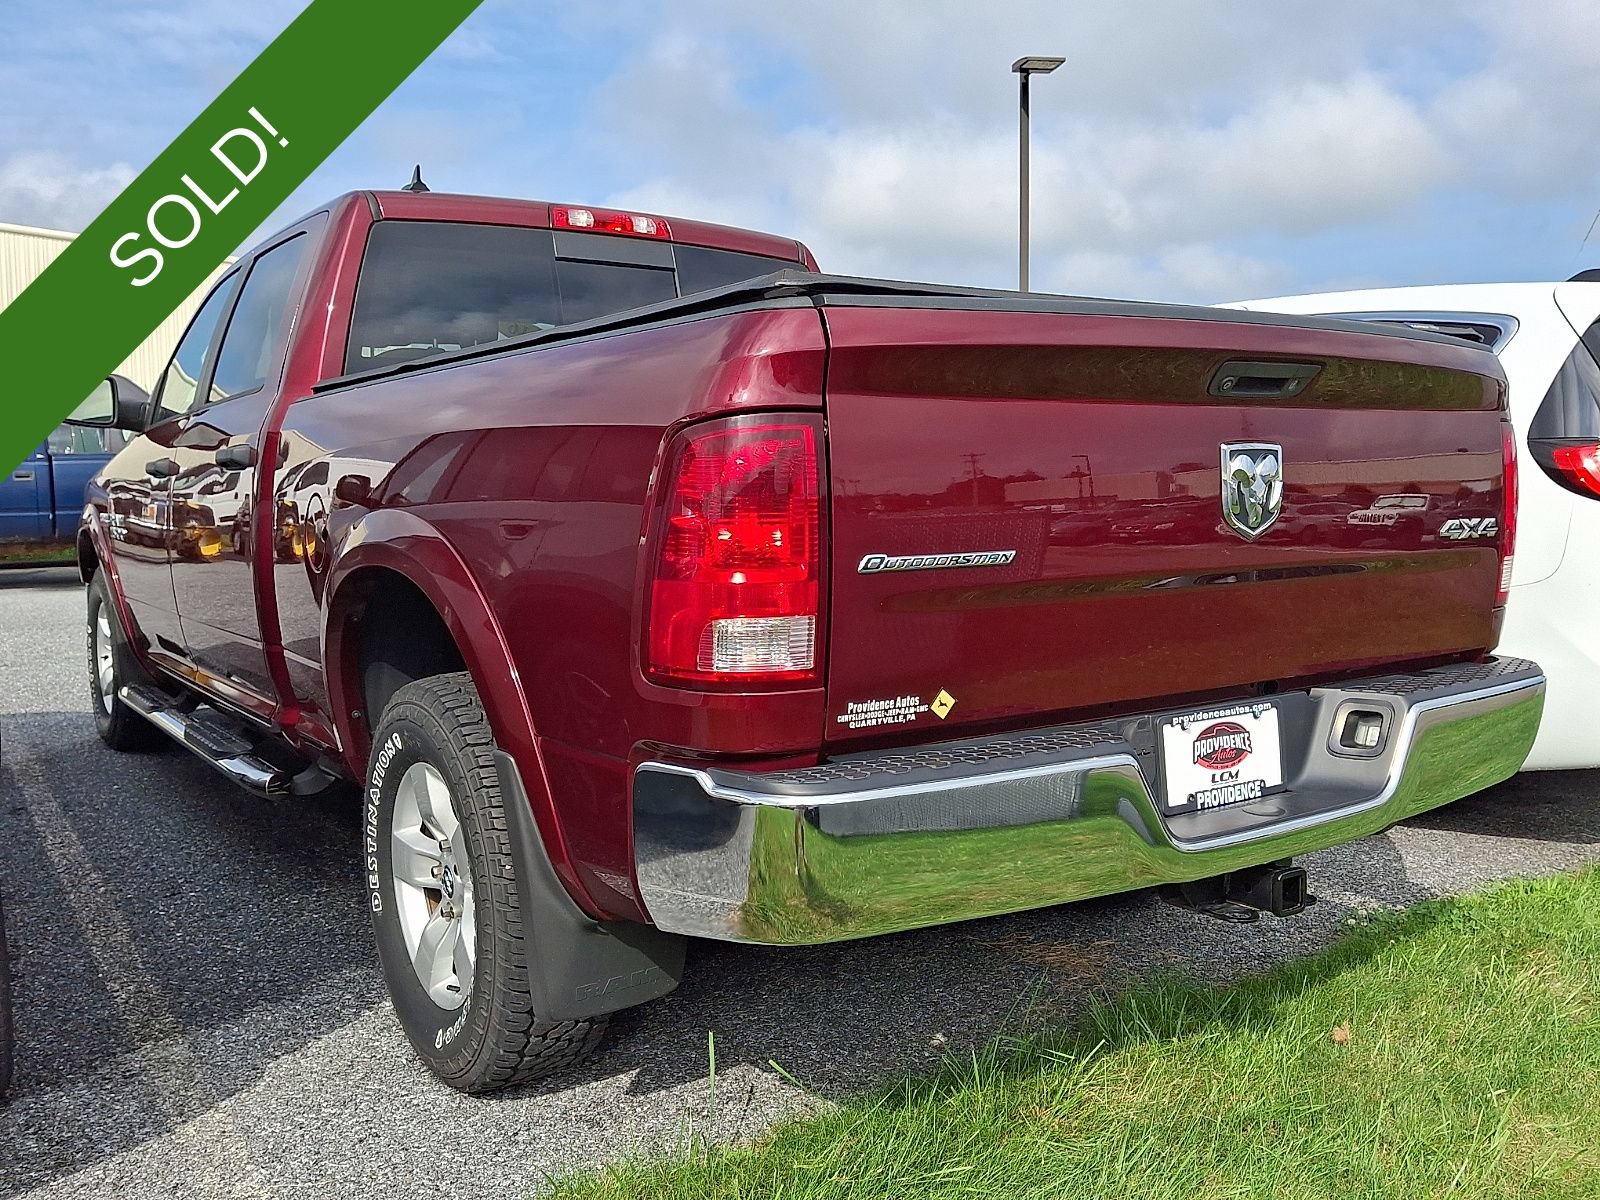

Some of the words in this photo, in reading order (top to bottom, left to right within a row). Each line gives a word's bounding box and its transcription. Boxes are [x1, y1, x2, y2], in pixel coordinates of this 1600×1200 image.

[848, 699, 895, 714] Providence
[896, 695, 920, 707] Autos
[1172, 702, 1272, 726] providenceautos.com
[906, 713, 916, 722] PA
[1194, 732, 1251, 763] PROVIDENCE
[1210, 747, 1238, 764] Autos
[1211, 769, 1240, 783] LCM
[1197, 780, 1262, 809] PROVIDENCE
[366, 738, 396, 912] DESTINATION
